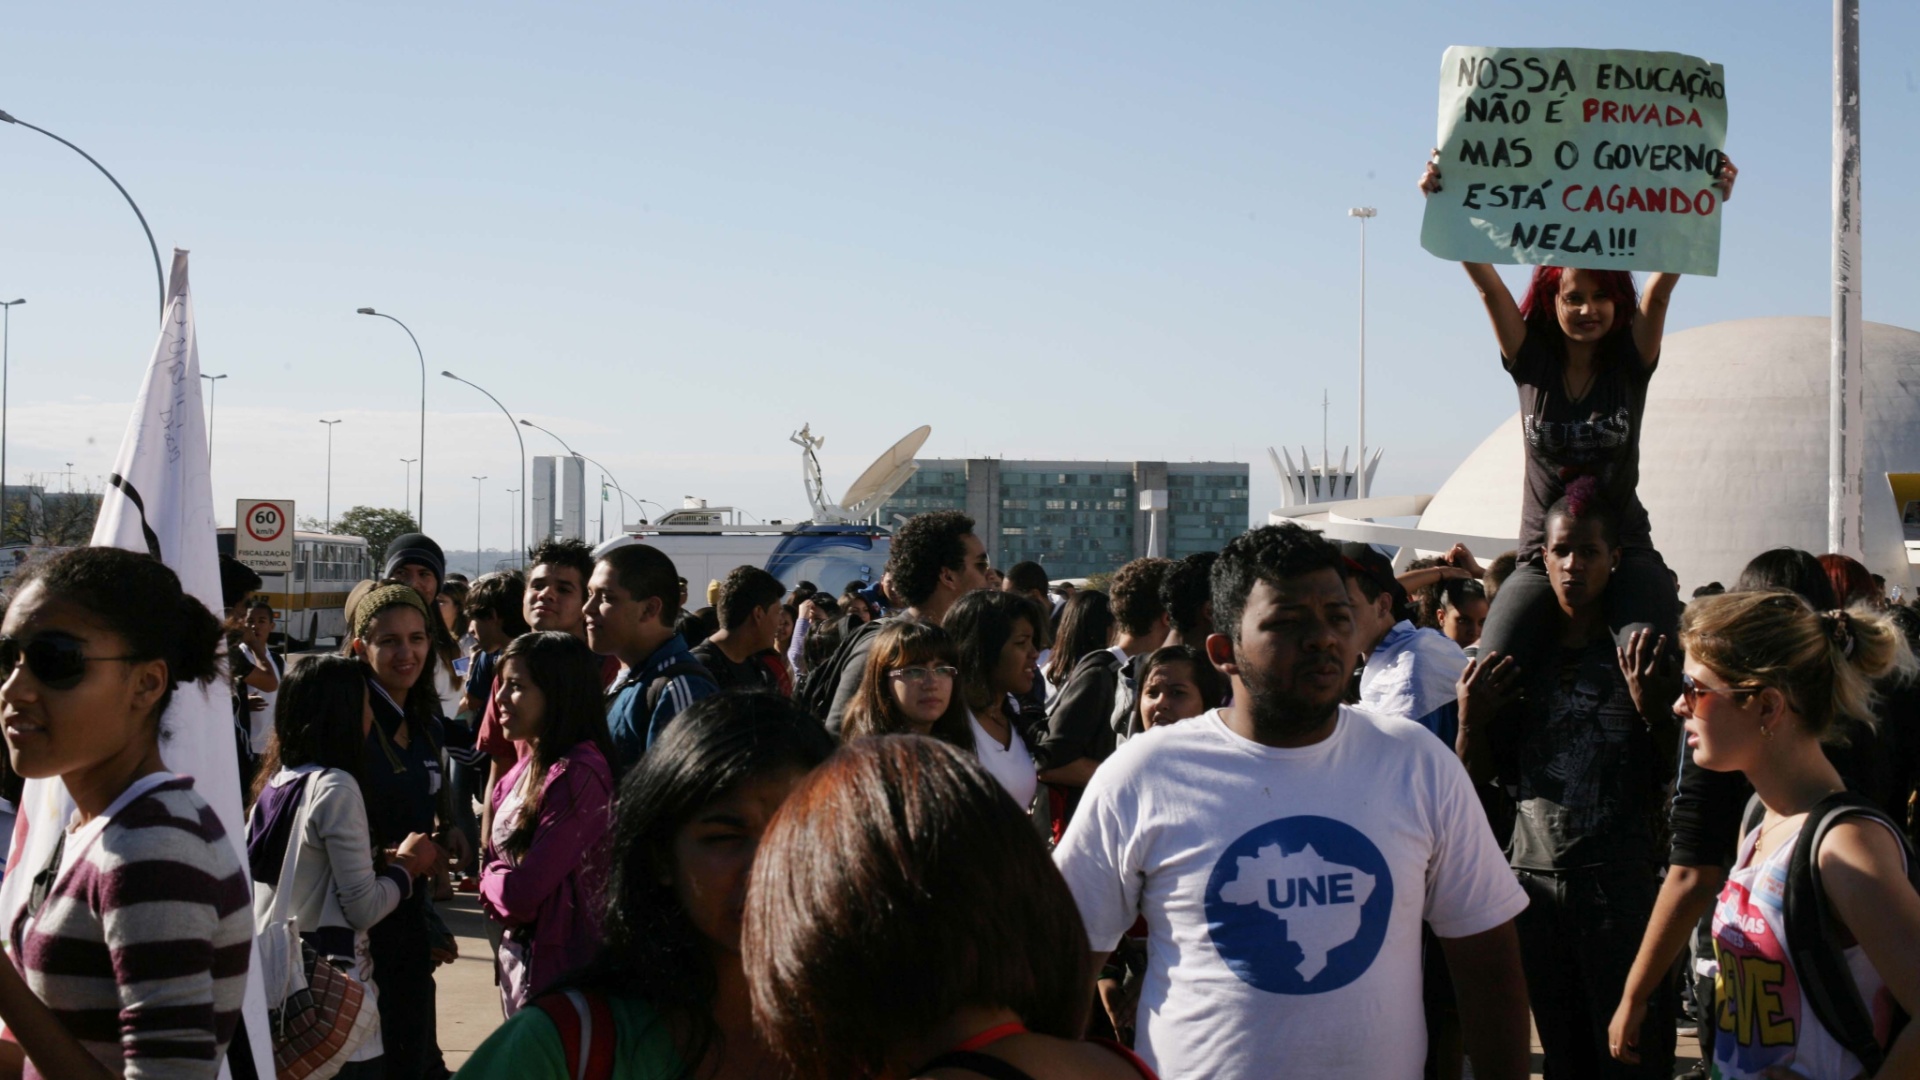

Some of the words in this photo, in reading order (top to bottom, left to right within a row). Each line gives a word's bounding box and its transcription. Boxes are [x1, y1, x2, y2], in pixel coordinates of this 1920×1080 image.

[1457, 56, 1577, 93] NOSSA
[1596, 64, 1725, 103] EDUCAÇÃO
[1464, 92, 1531, 124] NÃO
[1545, 91, 1569, 123] É
[1582, 98, 1703, 128] PRIVADA
[1459, 137, 1533, 168] MAS
[1554, 140, 1580, 170] O
[1593, 140, 1723, 179] GOVERNO
[1462, 179, 1553, 210] ESTÁ
[1562, 184, 1716, 216] CAGANDO
[1509, 222, 1638, 257] NELA!!!
[255, 510, 276, 525] 60
[256, 527, 275, 535] km/h
[238, 549, 291, 558] FISCALIZAÇÃO
[1267, 872, 1355, 909] UNE
